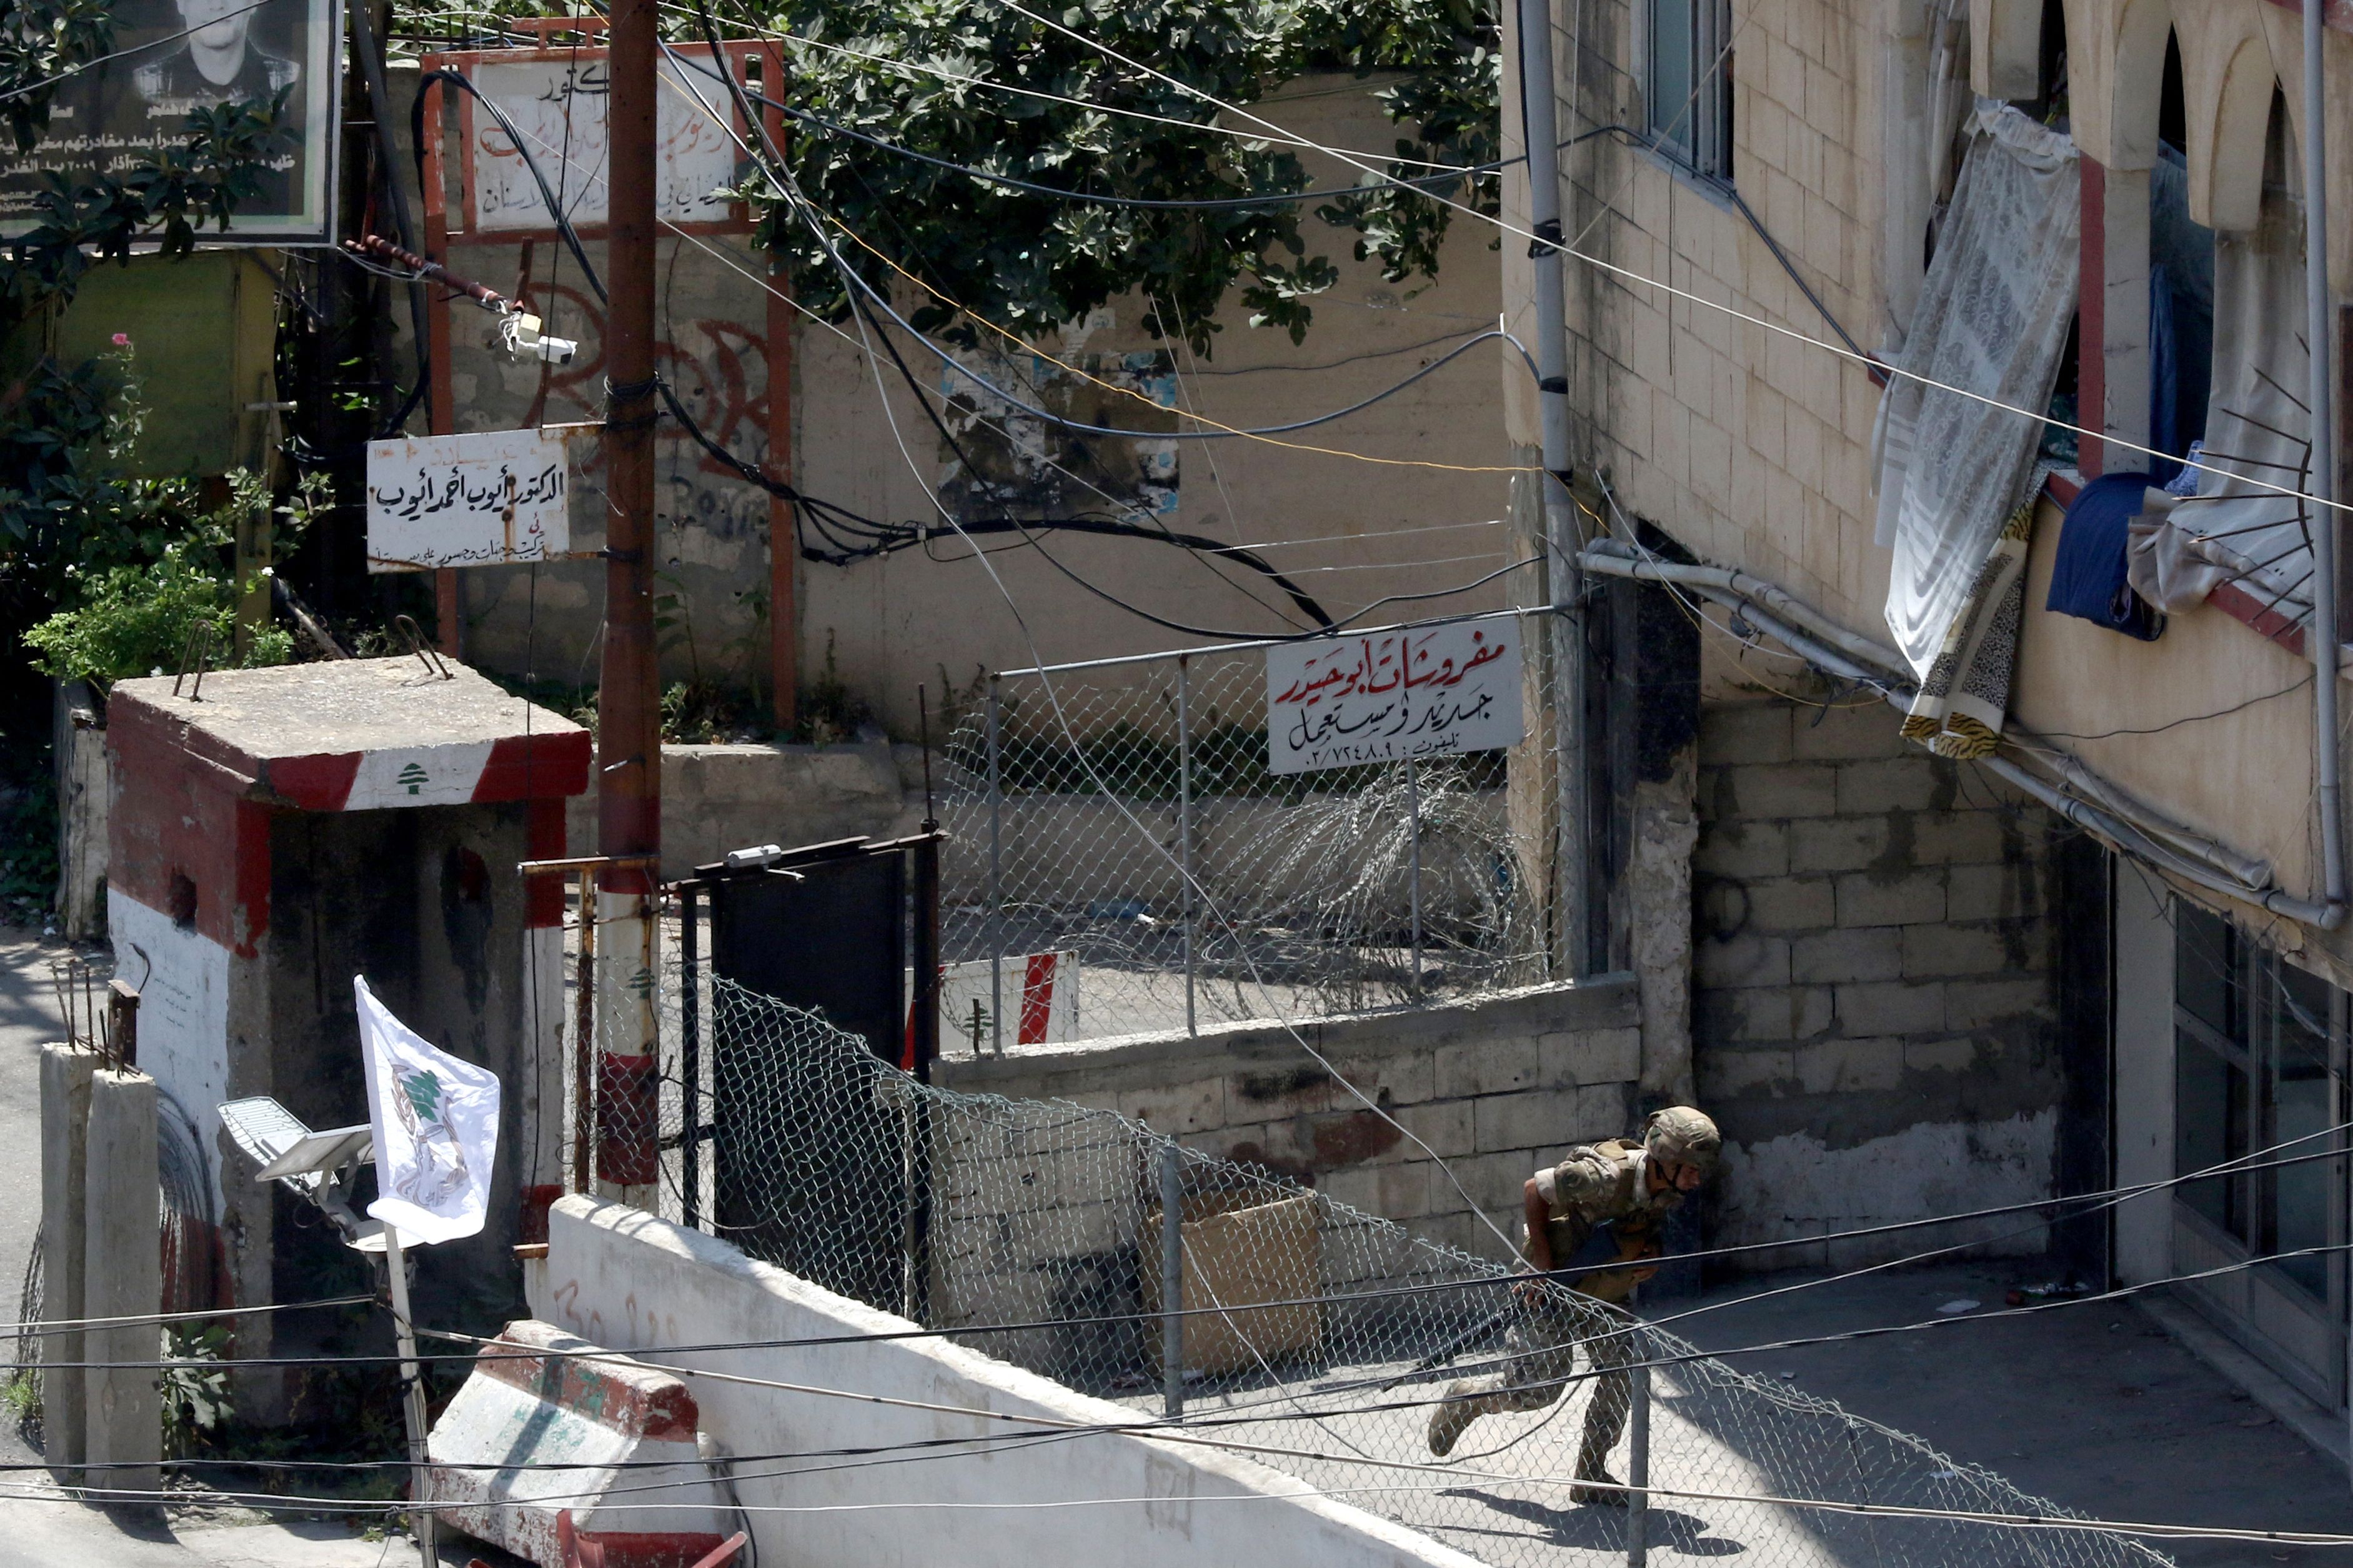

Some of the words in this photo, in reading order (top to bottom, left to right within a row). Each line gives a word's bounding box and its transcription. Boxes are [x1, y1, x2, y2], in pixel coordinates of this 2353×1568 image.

[507, 464, 564, 505] الدكتور
[1275, 647, 1345, 707] حيدر
[1368, 630, 1506, 694] مفروشات
[1407, 683, 1494, 735] جديد
